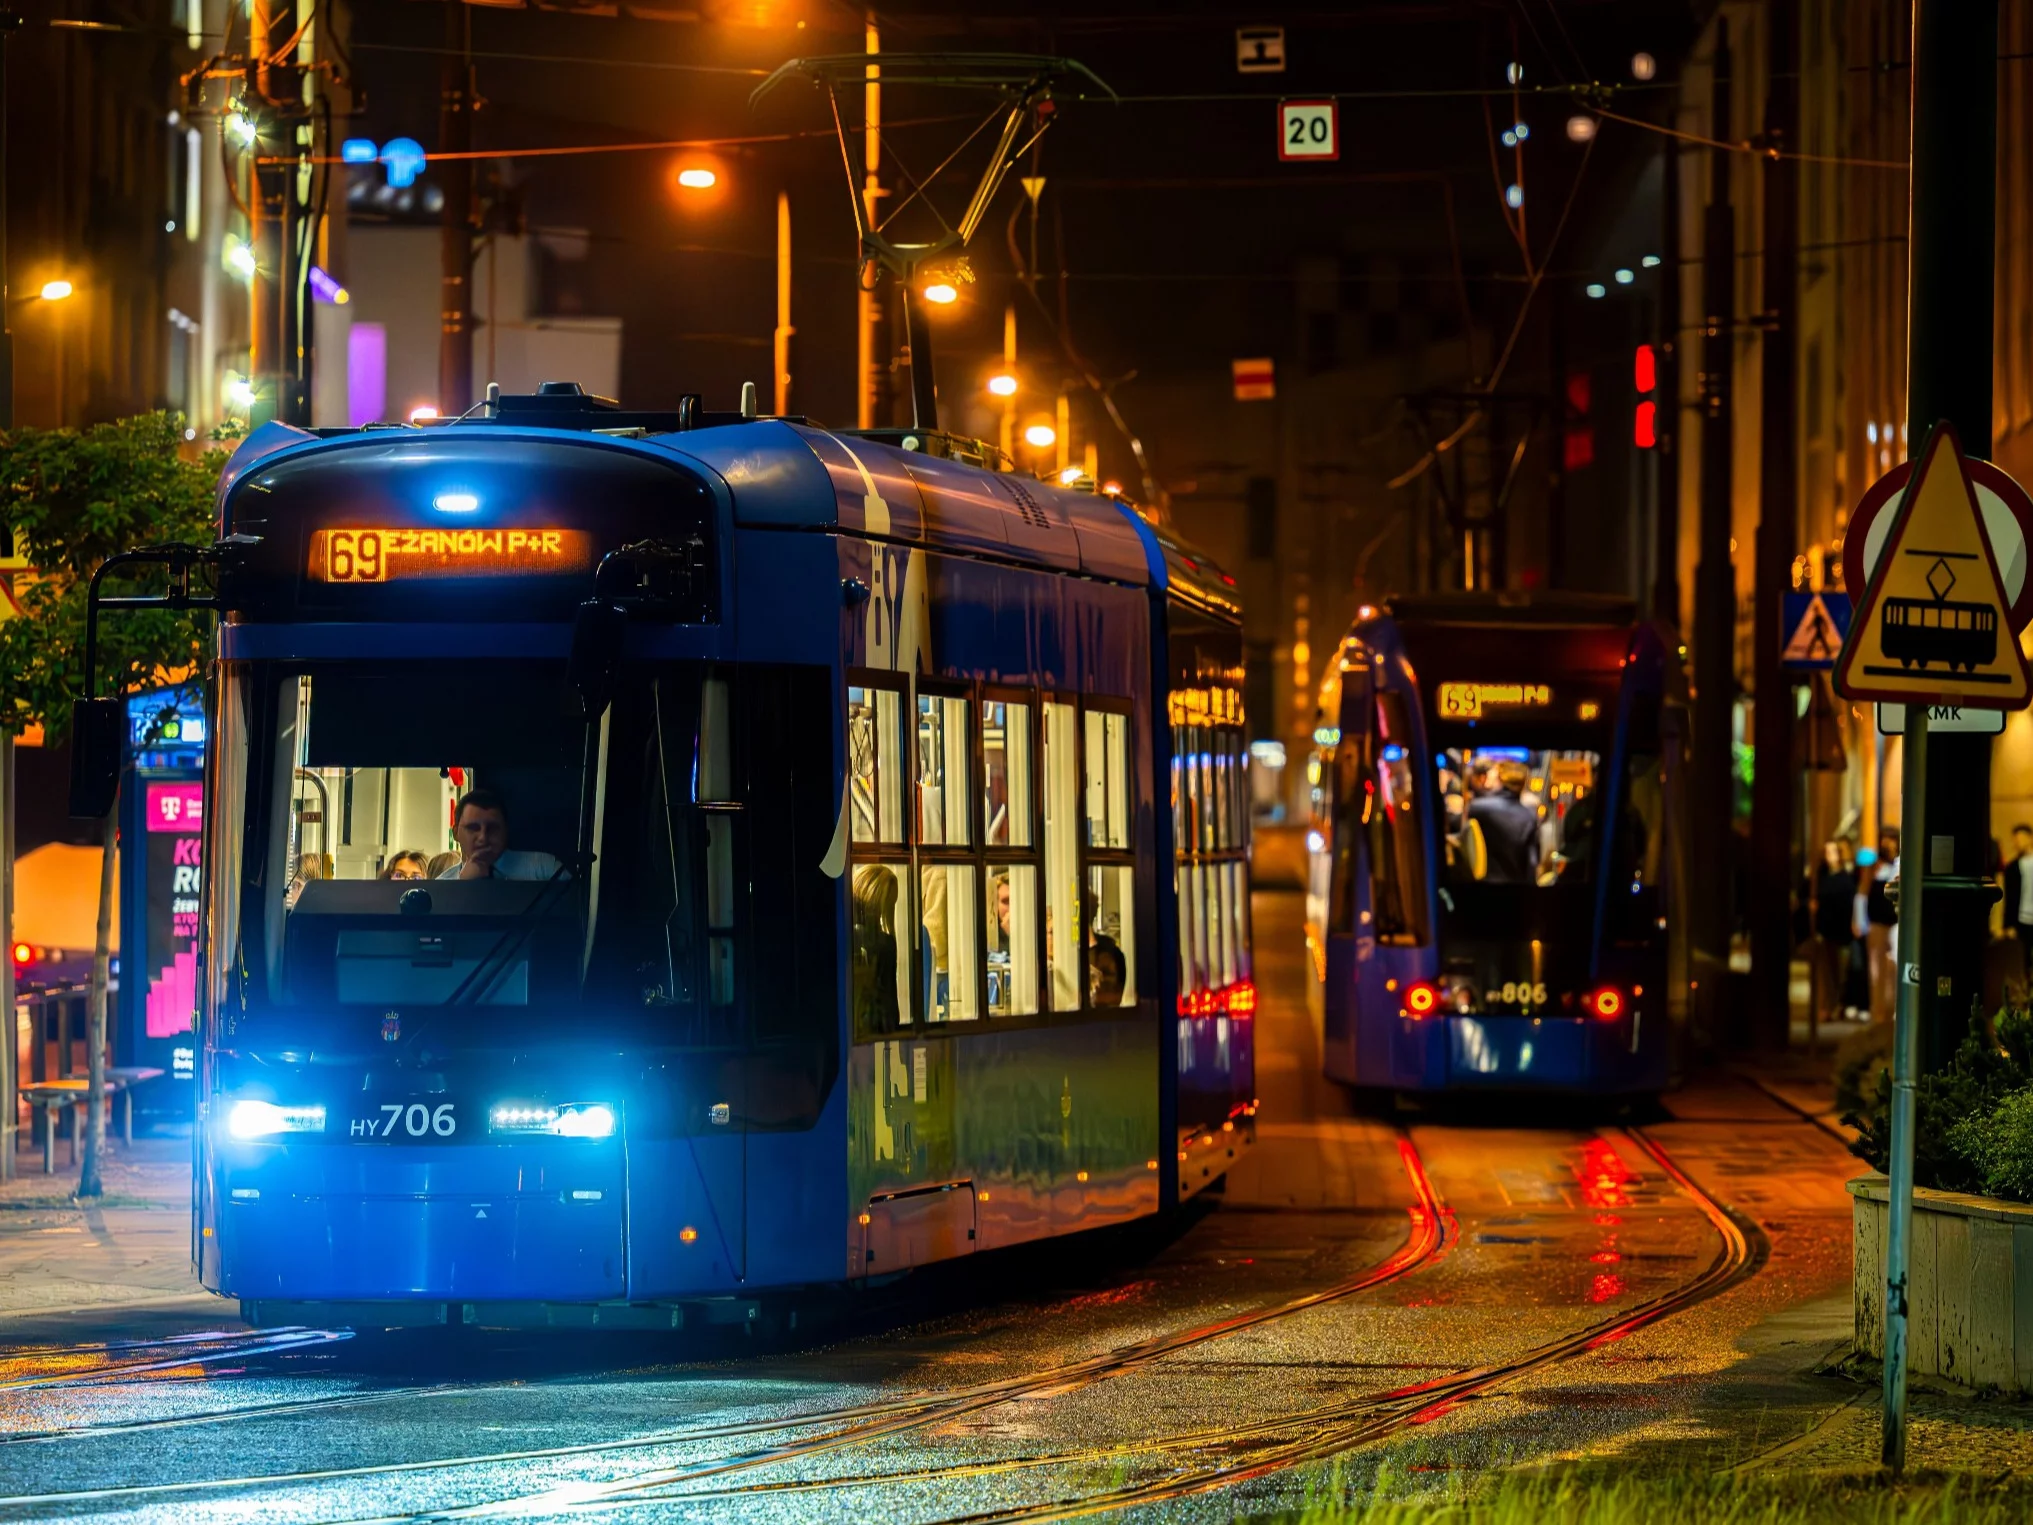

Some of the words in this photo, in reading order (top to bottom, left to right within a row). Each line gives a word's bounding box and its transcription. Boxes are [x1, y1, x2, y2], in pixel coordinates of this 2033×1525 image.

[1288, 116, 1328, 144] 20
[330, 531, 382, 580] 69
[508, 531, 561, 553] P+R
[1446, 685, 1477, 715] 69
[160, 796, 181, 821] T
